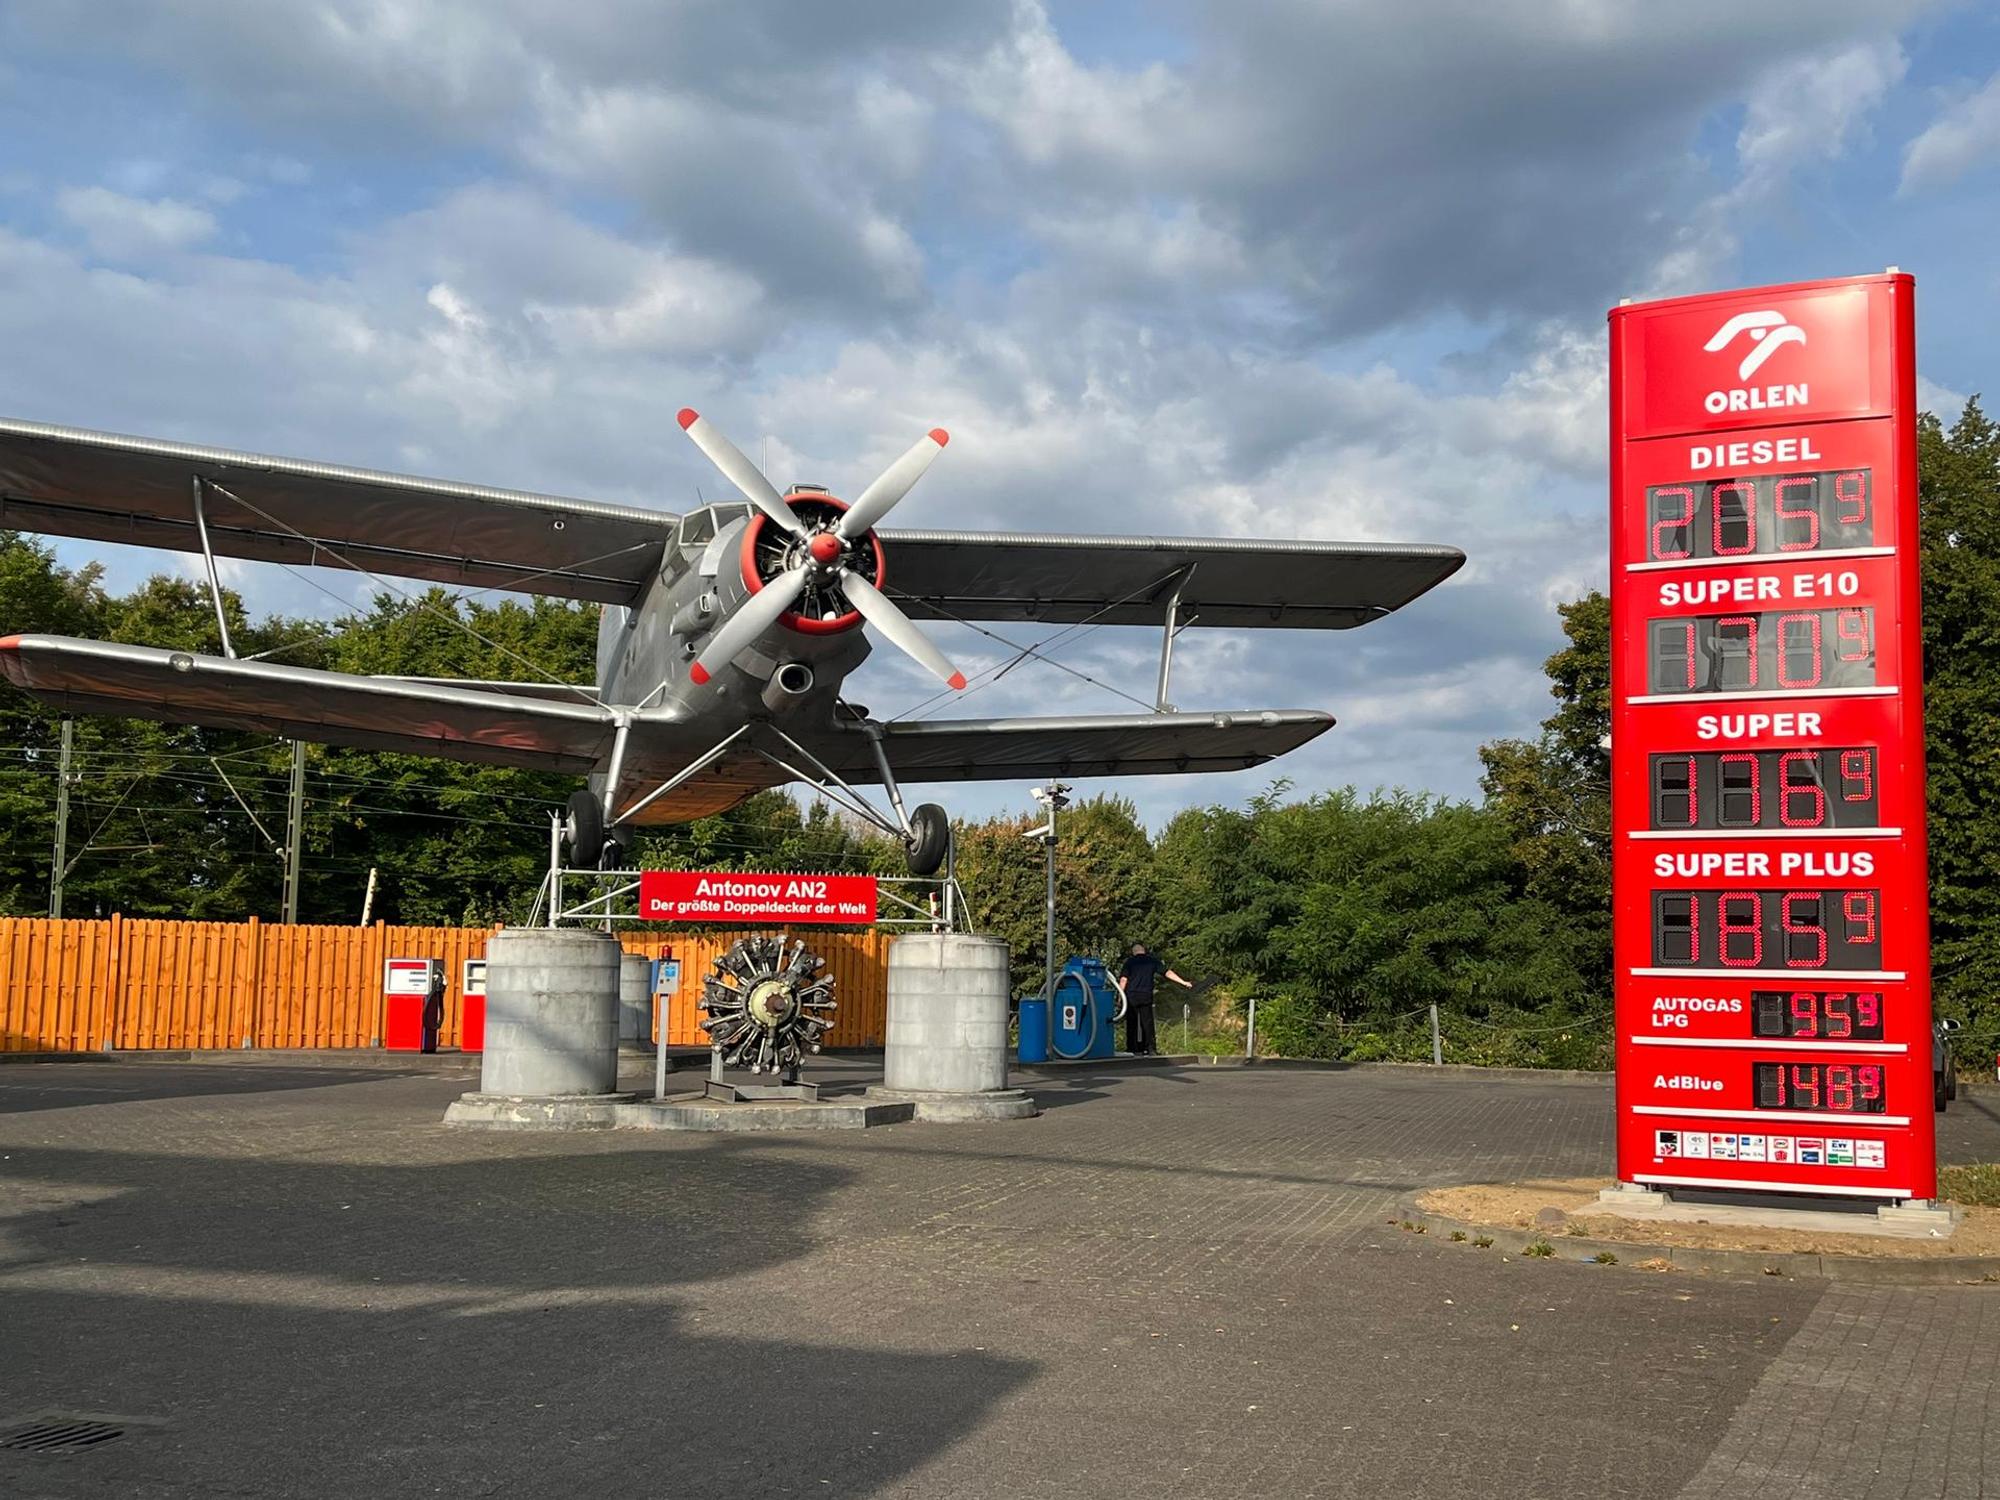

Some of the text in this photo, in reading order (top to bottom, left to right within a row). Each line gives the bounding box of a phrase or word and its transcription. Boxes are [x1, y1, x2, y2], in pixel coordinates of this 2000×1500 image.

[1705, 383, 1809, 414] ORLEN
[1691, 437, 1821, 469] DIESEL
[1660, 572, 1859, 606] SUPER E10
[1697, 712, 1822, 739] SUPER
[1654, 852, 1874, 877] SUPER PLUS
[695, 879, 827, 899] Antonov AN2
[651, 899, 867, 915] Der größte Doppeldecker der Welt
[1653, 997, 1742, 1013] AUTOGAS
[1652, 1013, 1689, 1028] LPG
[1654, 1075, 1724, 1091] AdBlue
